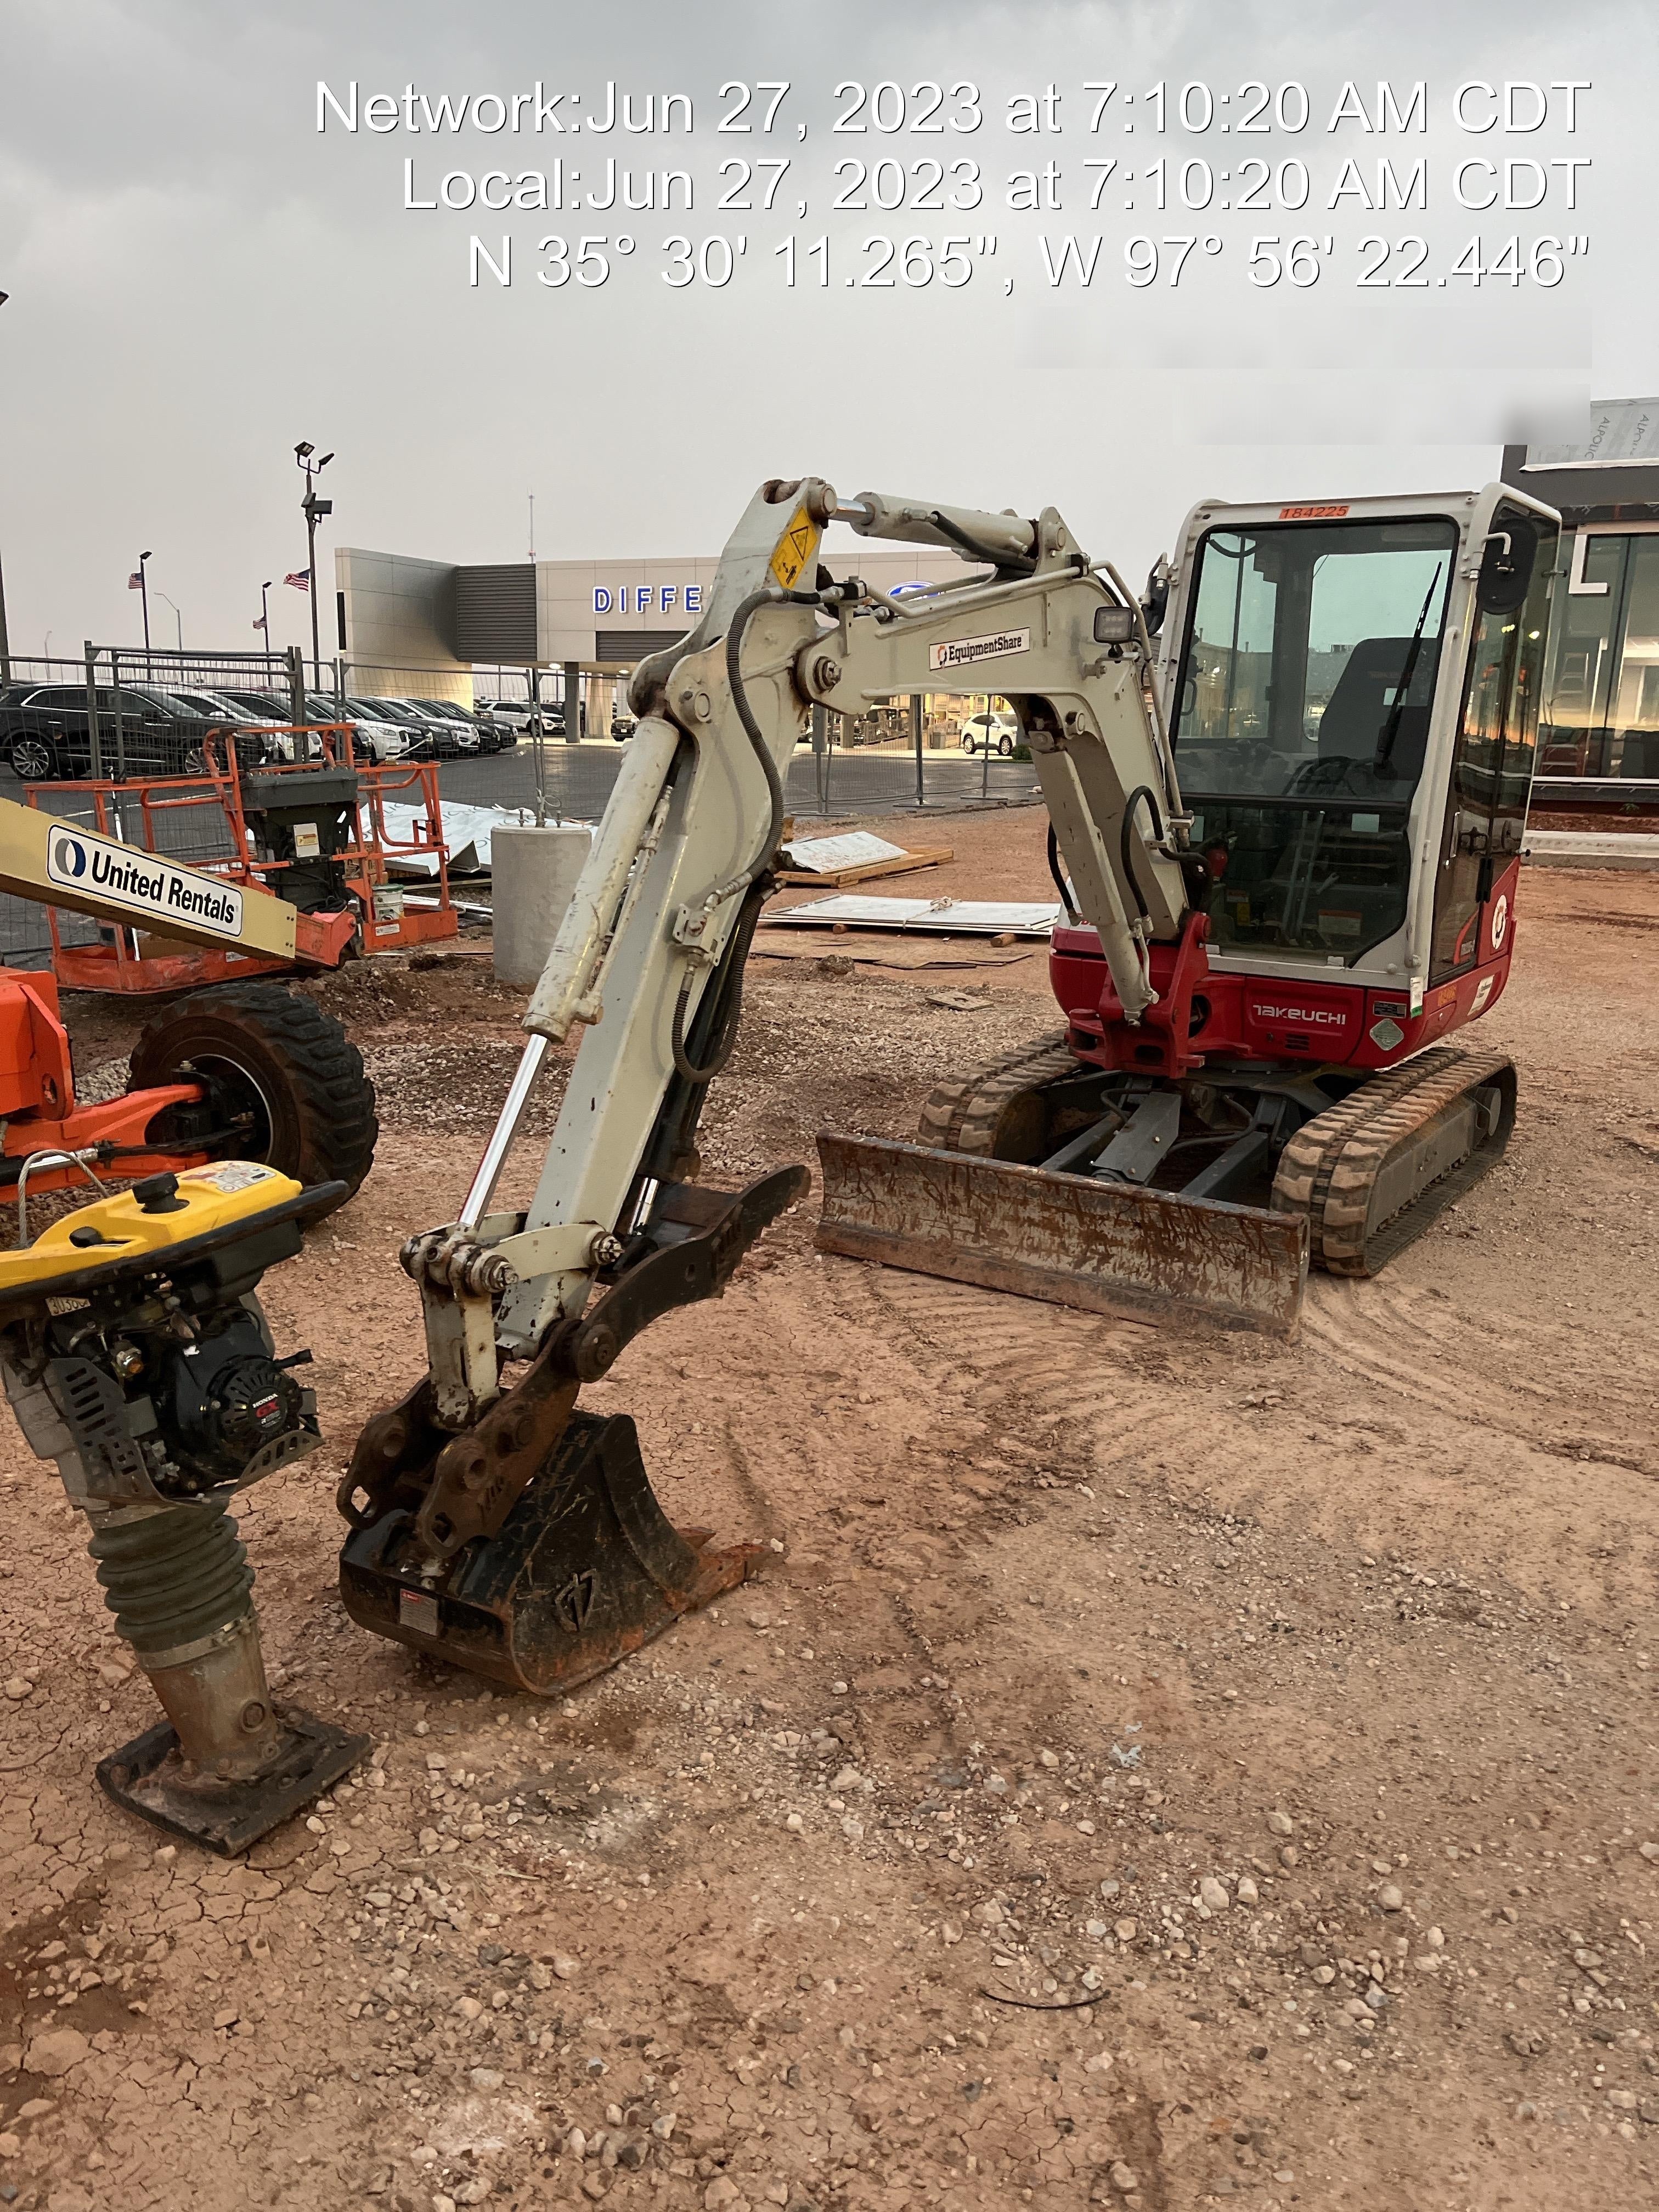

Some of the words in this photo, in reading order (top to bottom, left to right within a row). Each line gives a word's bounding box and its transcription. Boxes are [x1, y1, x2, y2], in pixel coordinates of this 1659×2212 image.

[1584, 417, 1610, 459] ALPOLIC
[1283, 506, 1350, 518] 184225
[593, 585, 713, 613] DIFFE
[949, 636, 1022, 663] EquipmentShare
[92, 850, 165, 902] United
[168, 877, 234, 924] Rentals
[252, 1393, 278, 1408] HONDA
